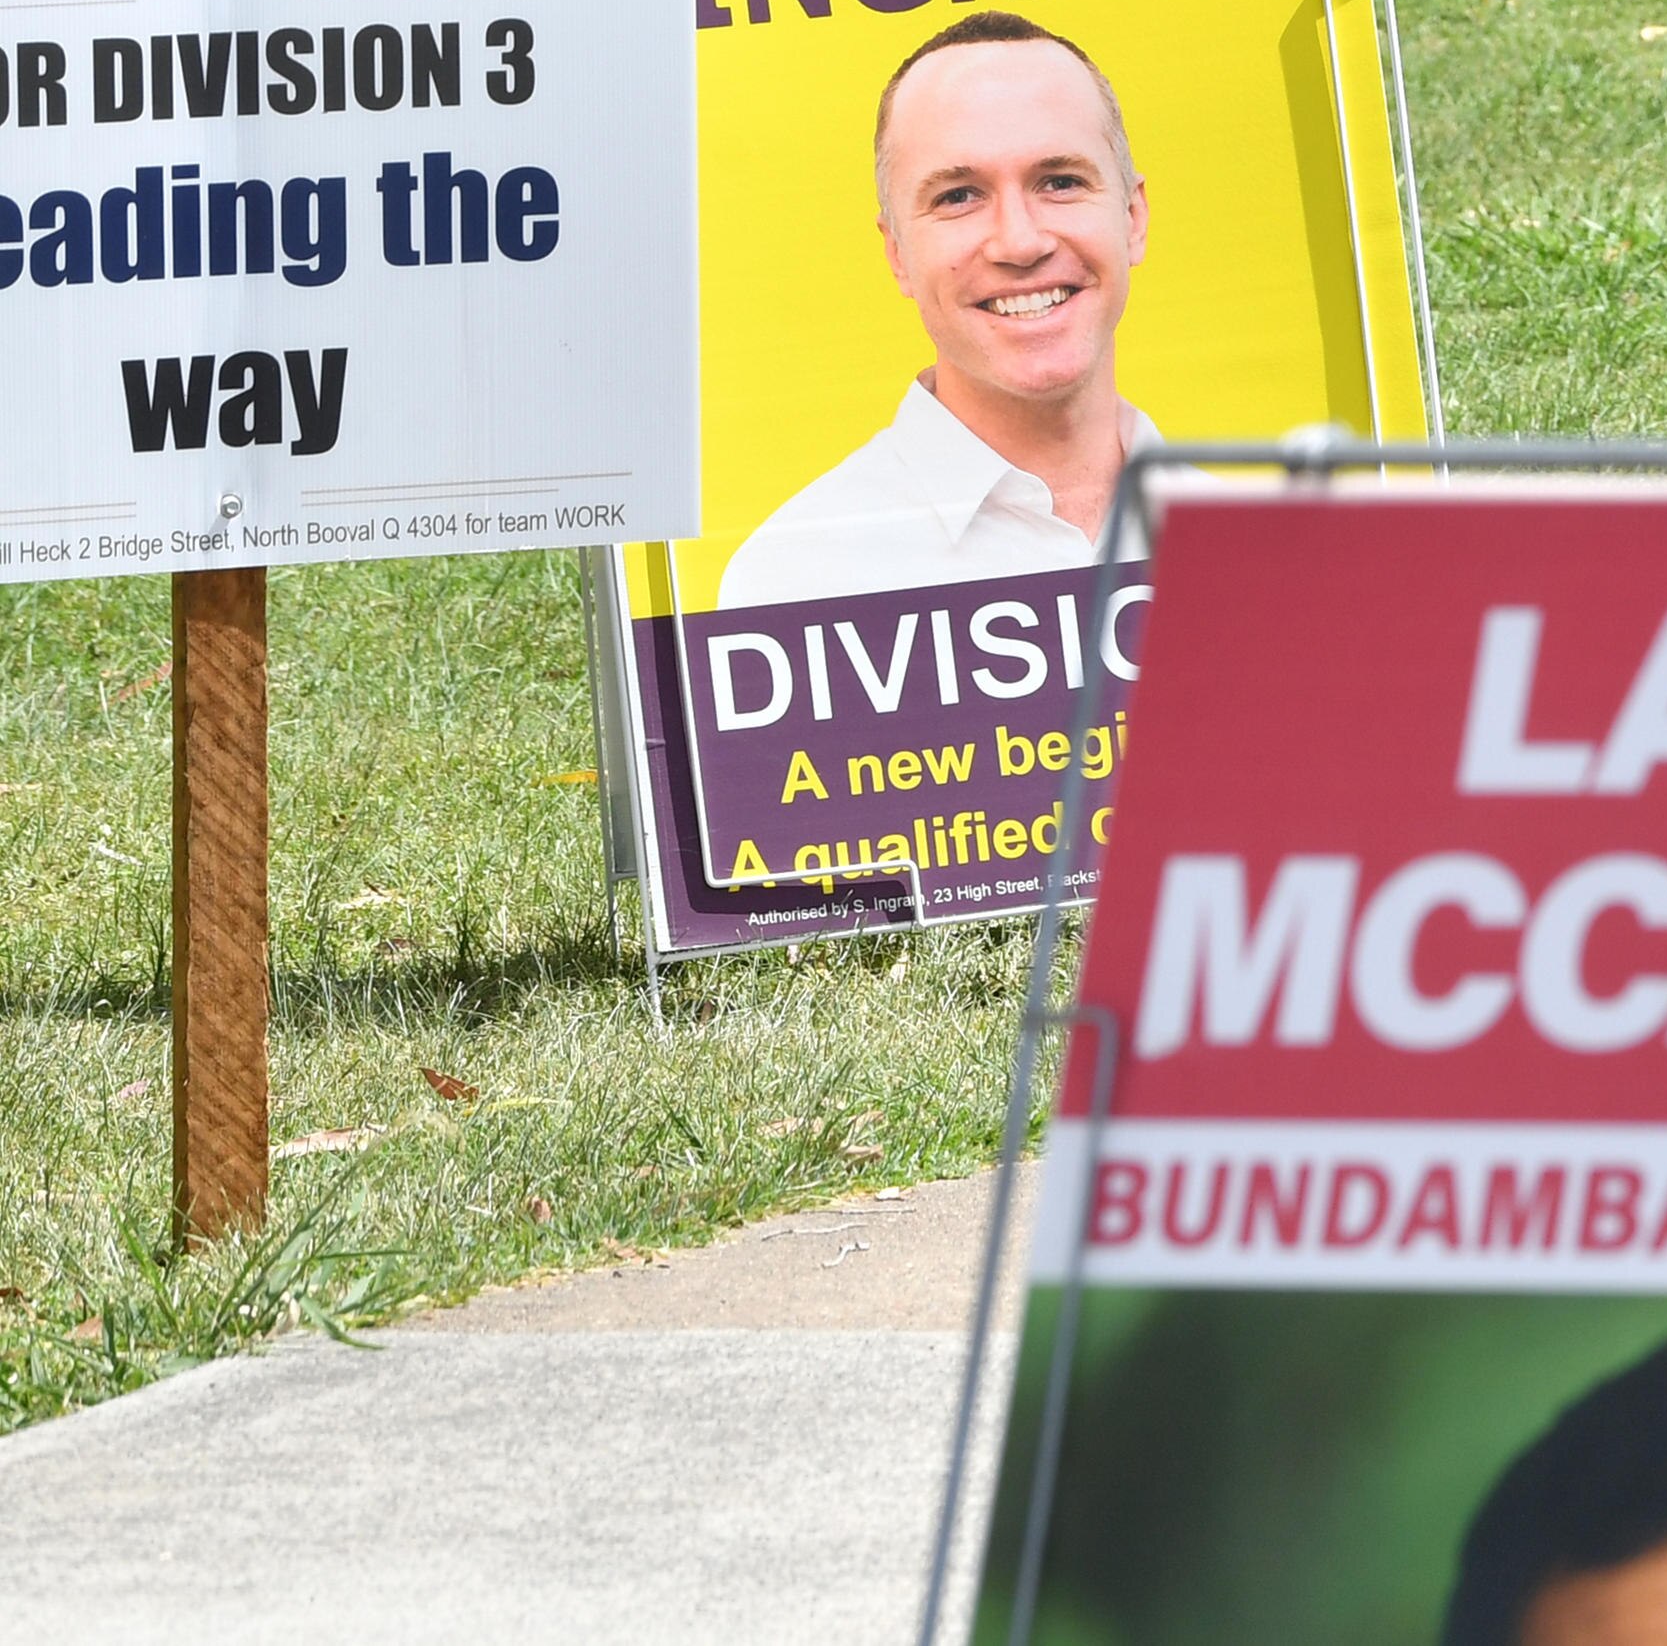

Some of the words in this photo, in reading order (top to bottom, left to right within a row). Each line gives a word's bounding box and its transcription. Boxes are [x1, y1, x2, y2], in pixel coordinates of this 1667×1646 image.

[92, 21, 462, 125] DIVISION
[484, 17, 536, 106] 3
[375, 150, 560, 267] the
[120, 346, 349, 456] way
[20, 537, 73, 563] Heck
[79, 537, 91, 560] 2
[98, 533, 164, 560] Bridge
[170, 528, 236, 553] Street,
[242, 524, 300, 548] North
[306, 518, 375, 545] Booval
[382, 517, 400, 541] Q
[406, 514, 459, 539] 4304
[465, 512, 492, 535] for
[498, 511, 549, 533] team
[554, 503, 627, 530] WORK
[780, 749, 830, 805] A
[847, 740, 977, 796] new
[727, 839, 777, 894] A
[792, 800, 1068, 895] qualified
[747, 904, 829, 927] Authorised
[831, 901, 850, 920] by
[852, 898, 869, 914] S.
[933, 887, 954, 903] 23
[956, 884, 992, 905] High
[995, 877, 1044, 897] Street,
